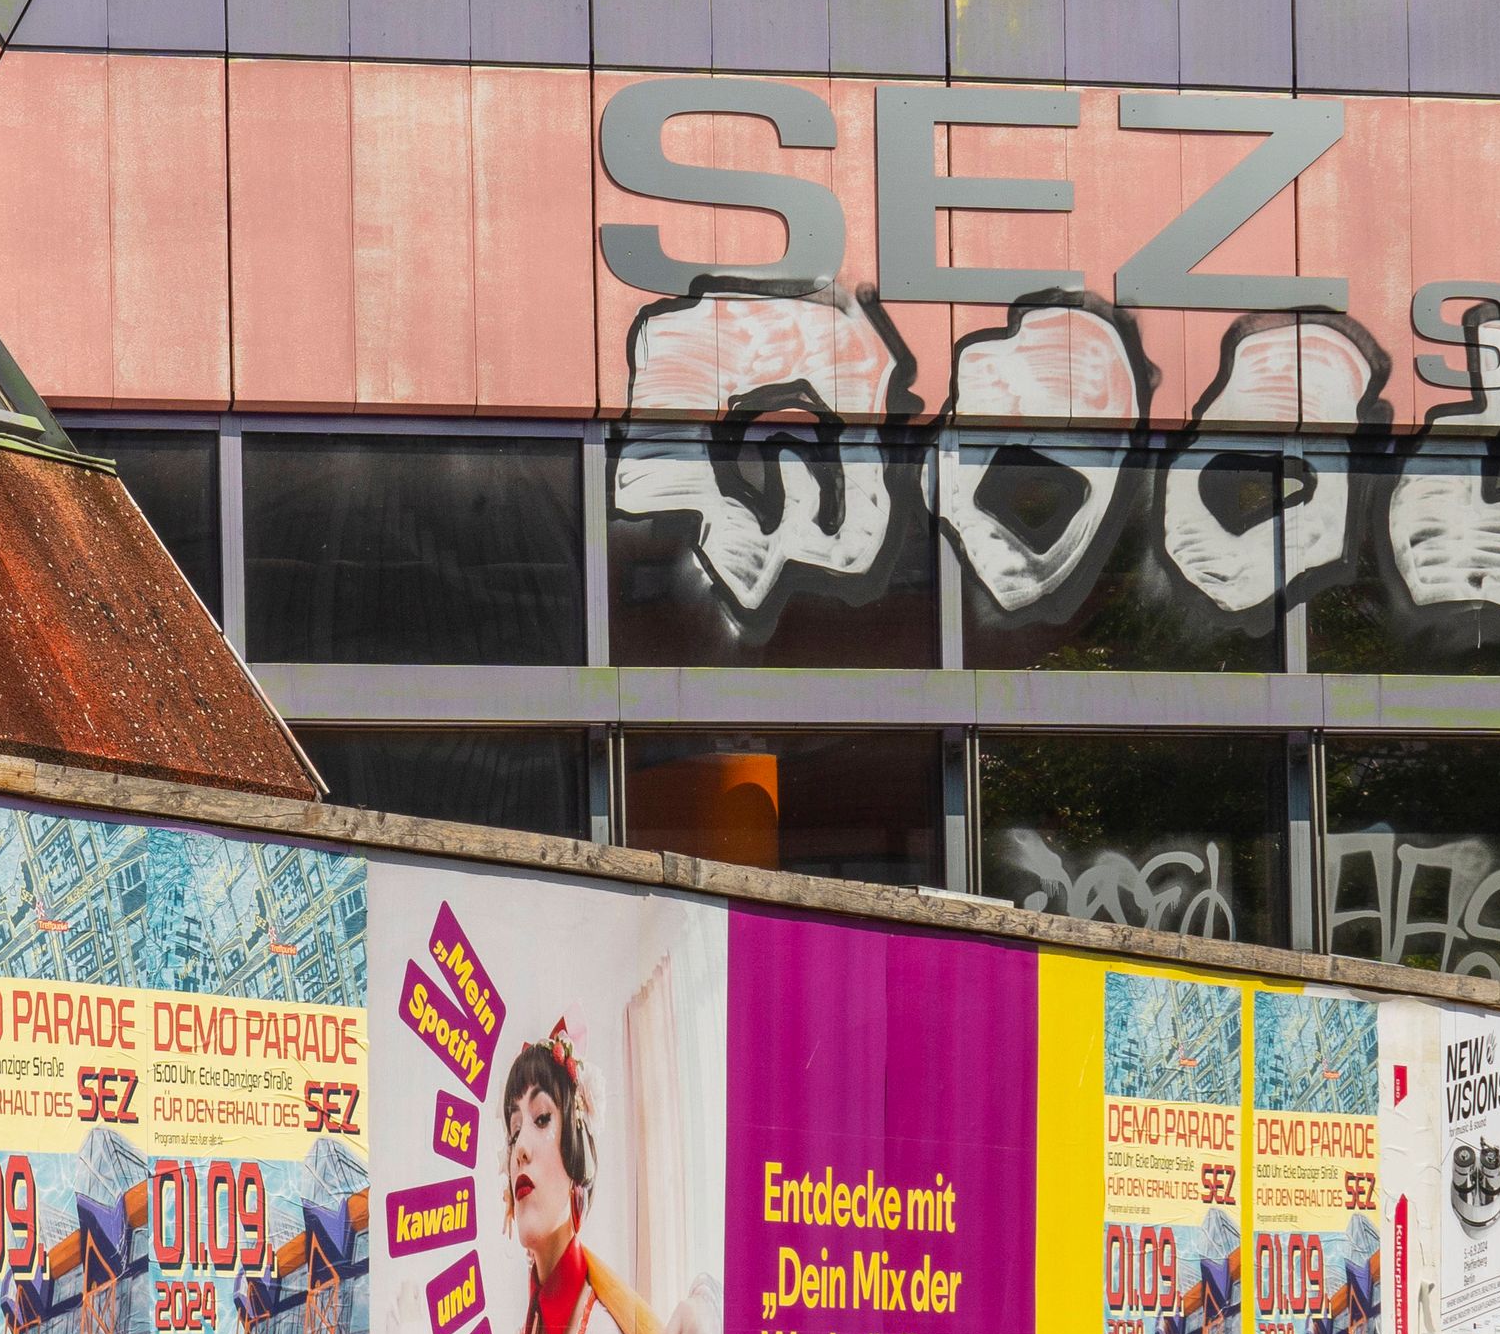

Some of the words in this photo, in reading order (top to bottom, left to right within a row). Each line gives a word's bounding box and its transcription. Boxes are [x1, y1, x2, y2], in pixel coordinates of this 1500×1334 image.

[600, 76, 1349, 314] SEZ
[12, 990, 136, 1050] PARADE
[153, 1001, 238, 1058] DEMO
[246, 1009, 358, 1065] PARADE
[406, 982, 487, 1084] Spotify
[1446, 1036, 1485, 1083] NEW
[77, 1065, 139, 1123] SEZ
[438, 1104, 472, 1153] ist
[1108, 1104, 1160, 1145] DEMO
[1165, 1107, 1235, 1151] PARADE
[395, 1188, 469, 1245] kawaii
[763, 1159, 903, 1231] Entdecke
[907, 1171, 957, 1235] mit
[434, 1266, 478, 1329] und
[760, 1247, 848, 1317] „Dein
[853, 1250, 907, 1314] Mix
[910, 1263, 962, 1314] der
